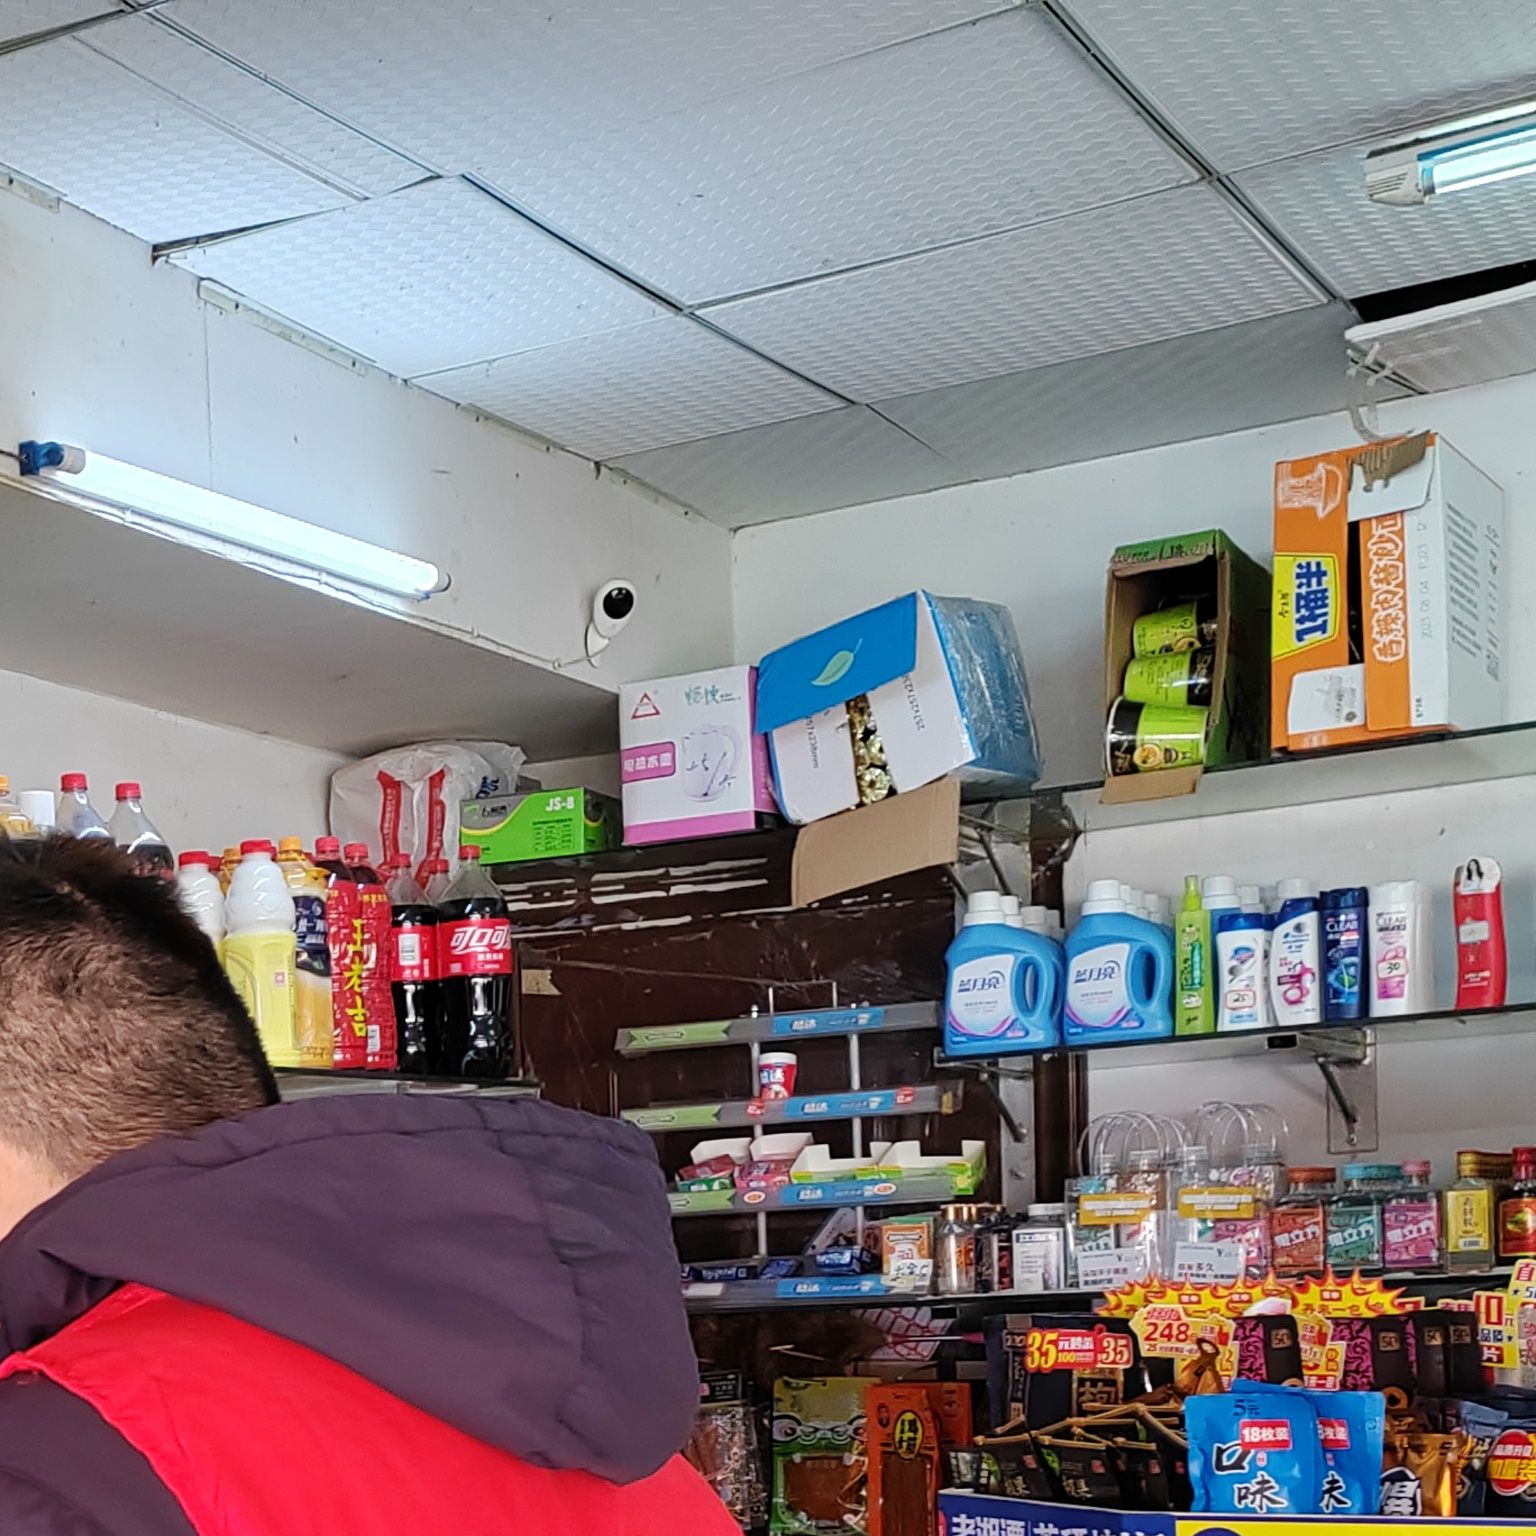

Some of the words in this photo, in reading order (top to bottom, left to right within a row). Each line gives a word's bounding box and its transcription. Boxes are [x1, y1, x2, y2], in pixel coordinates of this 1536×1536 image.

[1294, 560, 1329, 644] 1桶半
[1386, 962, 1401, 975] 30
[1144, 1322, 1190, 1342] 248
[1027, 1331, 1058, 1370] 35
[1100, 1337, 1130, 1364] 35
[1241, 1424, 1292, 1443] 18枚装
